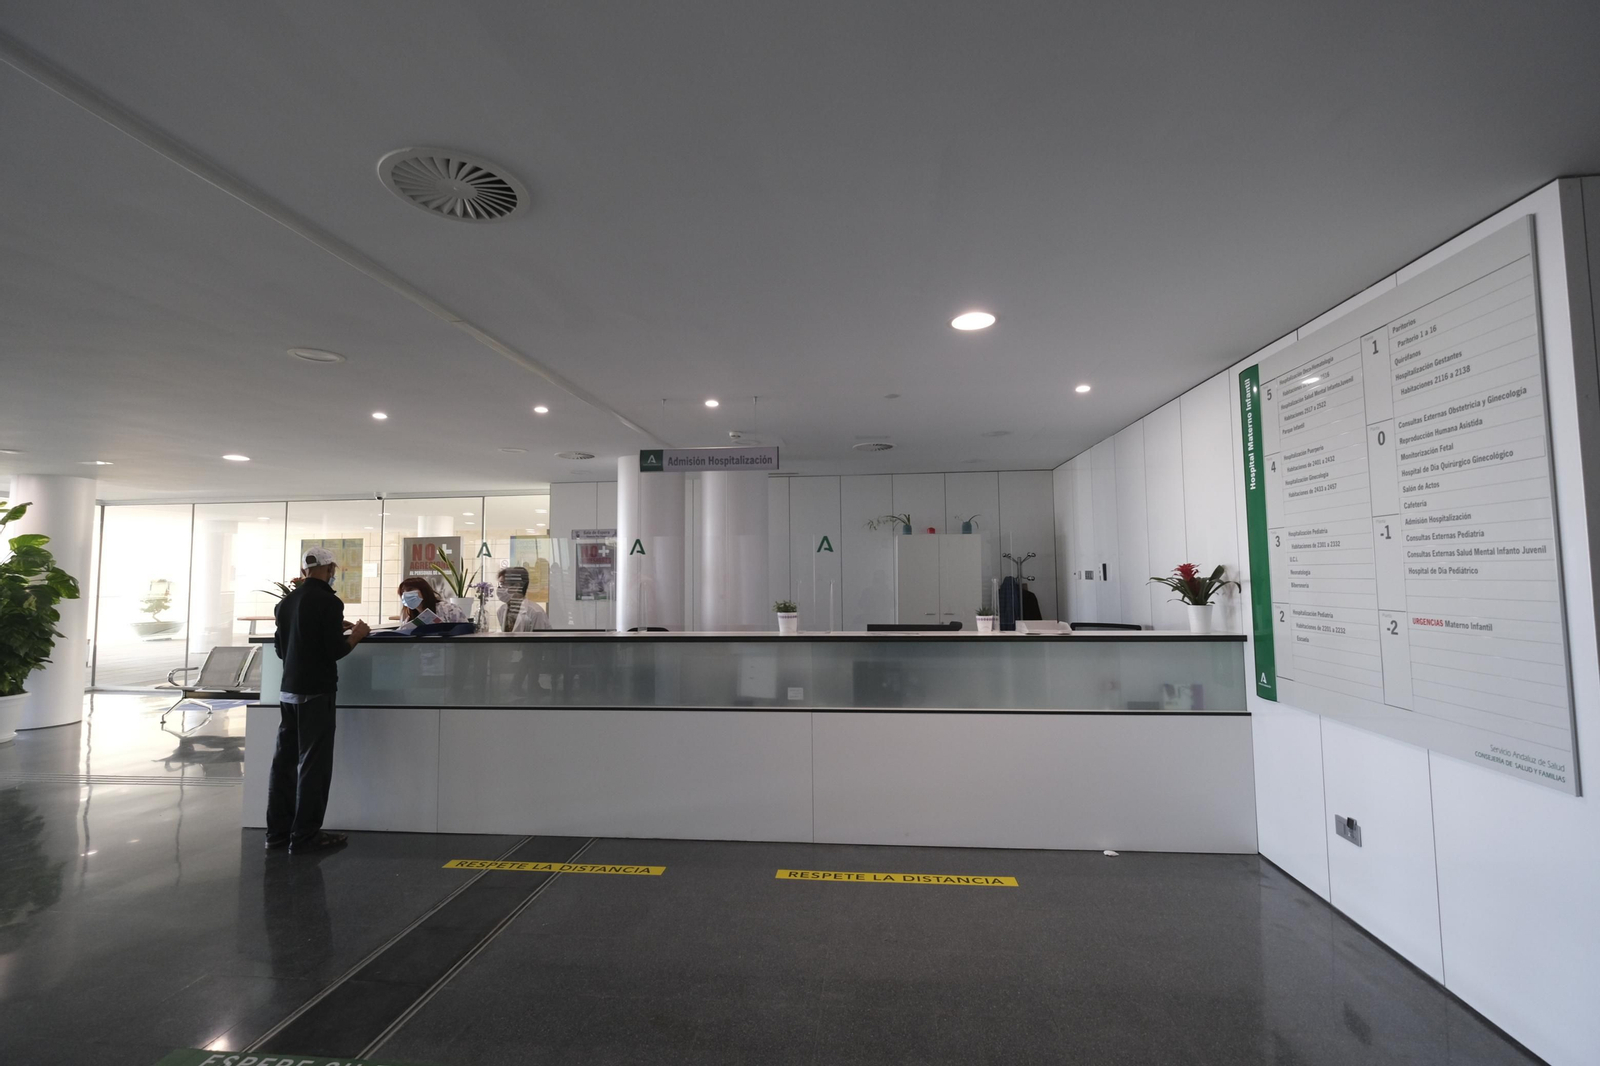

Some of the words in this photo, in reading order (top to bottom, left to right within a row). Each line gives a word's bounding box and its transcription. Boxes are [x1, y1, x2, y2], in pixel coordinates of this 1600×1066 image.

[1392, 319, 1416, 334] Paritorios
[1397, 334, 1419, 348] Paritorio
[1430, 324, 1437, 334] 16
[1372, 339, 1379, 355] 1
[1394, 350, 1421, 366] Quirófanos
[1395, 361, 1433, 381] Hospitalización
[1434, 351, 1462, 367] Gestantes
[1401, 380, 1433, 395] Habitaciones
[1434, 373, 1449, 384] 2116
[1455, 365, 1470, 377] 2138
[1244, 378, 1252, 411] Infantil
[1266, 388, 1272, 401] 5
[1398, 416, 1422, 429] Consultas
[1424, 410, 1448, 422] Externas
[1448, 400, 1480, 414] Obstetricia
[1482, 399, 1486, 407] y
[1488, 386, 1528, 404] Ginecología
[1246, 412, 1254, 451] Materno
[1378, 430, 1386, 446] 0
[1400, 430, 1434, 445] Reproducción
[1434, 423, 1458, 436] Humana
[1459, 418, 1483, 430] Asistida
[1400, 446, 1438, 461] Monitorización
[1440, 442, 1454, 452] Fetal
[668, 456, 706, 466] Admisión
[708, 455, 772, 468] Hospitalización
[1271, 461, 1276, 473] 4
[1402, 466, 1422, 477] Hospital
[1430, 463, 1440, 472] Día
[1440, 456, 1471, 470] Quirúrgico
[1472, 450, 1514, 464] Ginecológico
[1402, 484, 1416, 493] Salón
[1424, 480, 1440, 490] Actos
[1404, 500, 1427, 509] Cafetería
[1405, 516, 1428, 525] Admisión
[1429, 512, 1472, 523] Hospitalización
[1380, 525, 1392, 540] -1
[1406, 532, 1431, 542] Consultas
[1432, 531, 1456, 540] Externas
[1458, 529, 1484, 538] Pediatría
[1275, 536, 1280, 547] 3
[1407, 550, 1432, 558] Consultas
[1432, 550, 1456, 558] Externas
[1456, 548, 1472, 556] Salud
[1474, 547, 1496, 556] Mental
[1497, 546, 1520, 555] Infanto
[1522, 545, 1546, 554] Juvenil
[1408, 567, 1430, 575] Hospital
[1438, 566, 1448, 574] Día
[1448, 566, 1478, 574] Pediátrico
[1280, 610, 1284, 622] 2
[1386, 620, 1398, 635] -2
[1412, 618, 1444, 627] URGENCIAS
[1444, 620, 1470, 630] Materno
[1470, 622, 1493, 631] Infantil
[1490, 744, 1512, 757] Servicio
[1512, 750, 1536, 764] Andaluz
[1538, 758, 1546, 767] de
[1547, 760, 1565, 772] Salud
[1506, 760, 1513, 768] DE
[1514, 762, 1533, 773] SALUD
[1538, 770, 1566, 783] FAMILIAS
[455, 860, 530, 870] RESPETE
[559, 864, 651, 874] DISTANCIA
[788, 871, 866, 880] RESPETE
[873, 874, 895, 882] LA
[902, 875, 1004, 885] DISTANCIA
